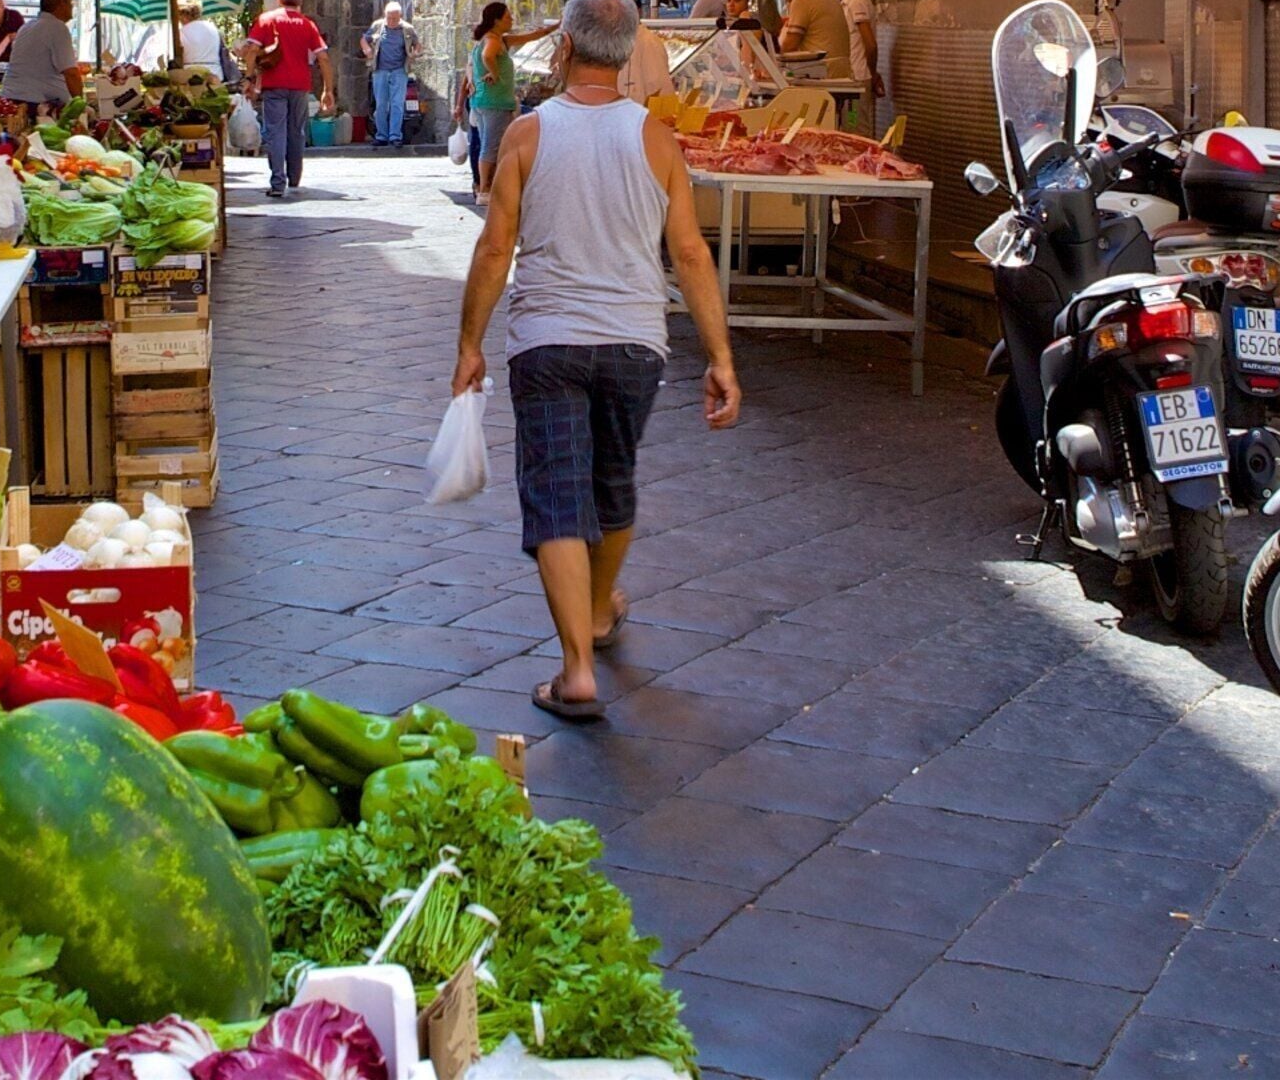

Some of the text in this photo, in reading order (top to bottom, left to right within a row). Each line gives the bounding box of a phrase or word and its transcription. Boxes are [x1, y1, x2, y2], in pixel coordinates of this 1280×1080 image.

[1247, 309, 1267, 329] DN
[1159, 394, 1187, 421] EB
[1153, 424, 1220, 457] 71622
